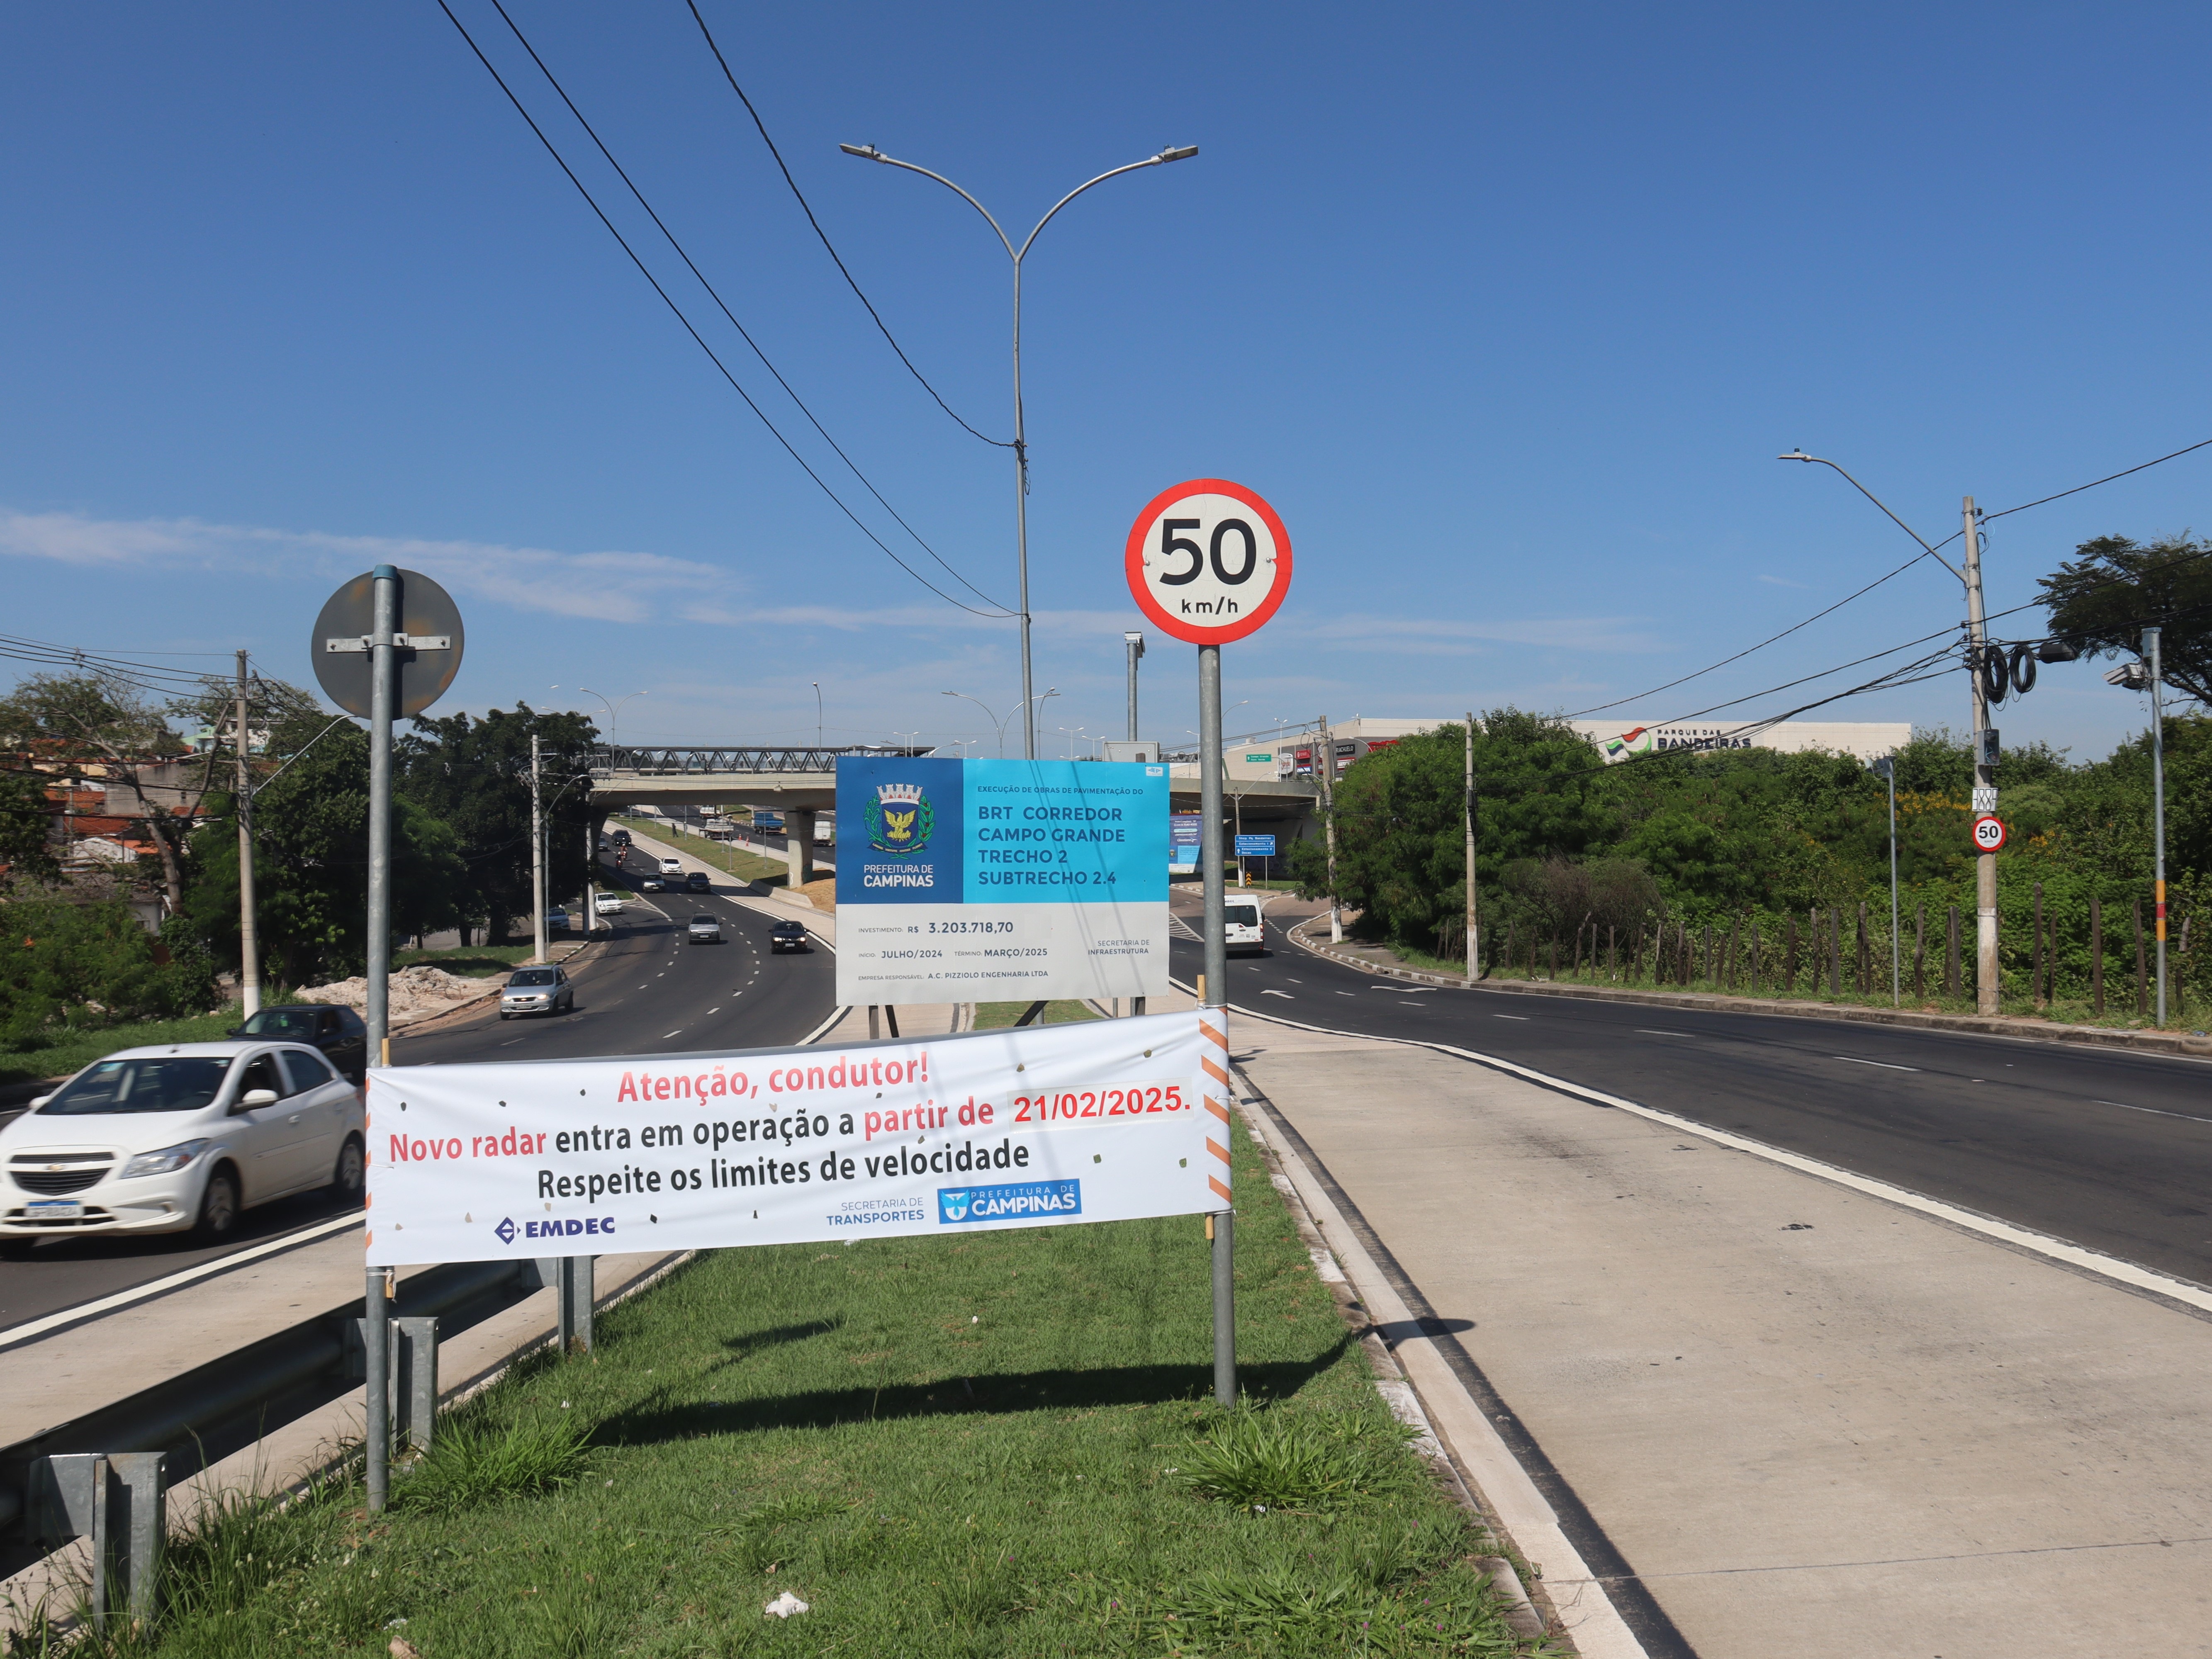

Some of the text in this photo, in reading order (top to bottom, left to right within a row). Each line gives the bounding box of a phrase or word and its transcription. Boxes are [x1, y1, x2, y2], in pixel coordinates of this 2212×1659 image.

[1159, 518, 1256, 585] 50
[1182, 596, 1238, 615] km/h
[1658, 738, 1751, 749] BANDEIRAS
[978, 785, 1020, 794] EXECUÇÃO
[979, 807, 1122, 821] BRT CORREDOR
[978, 828, 1125, 842] CAMPO GRANDE
[1979, 826, 1998, 839] 50
[978, 850, 1068, 863] TRECHO 2
[864, 864, 933, 873] PREFEITURA DE
[864, 875, 934, 887] CAMPINAS
[978, 871, 1116, 885] SUBTRECHO 2.4
[928, 922, 1013, 934] 3.203.718,70
[881, 949, 943, 959] JULHO/2024
[984, 948, 1048, 958] MARÇO/2025
[618, 1051, 928, 1106] Atenção, condutor!
[390, 1086, 1190, 1162] Novo radar entra em operação a partir de 21/02/2025.
[539, 1138, 1029, 1204] Respeite os limites de velocidade
[971, 1187, 1051, 1199] PREFEITURA
[841, 1197, 924, 1211] SECRETARIA DE
[971, 1193, 1076, 1216] CAMPINAS
[827, 1210, 924, 1225] TRANSPORTES
[526, 1217, 615, 1238] EMDEC
